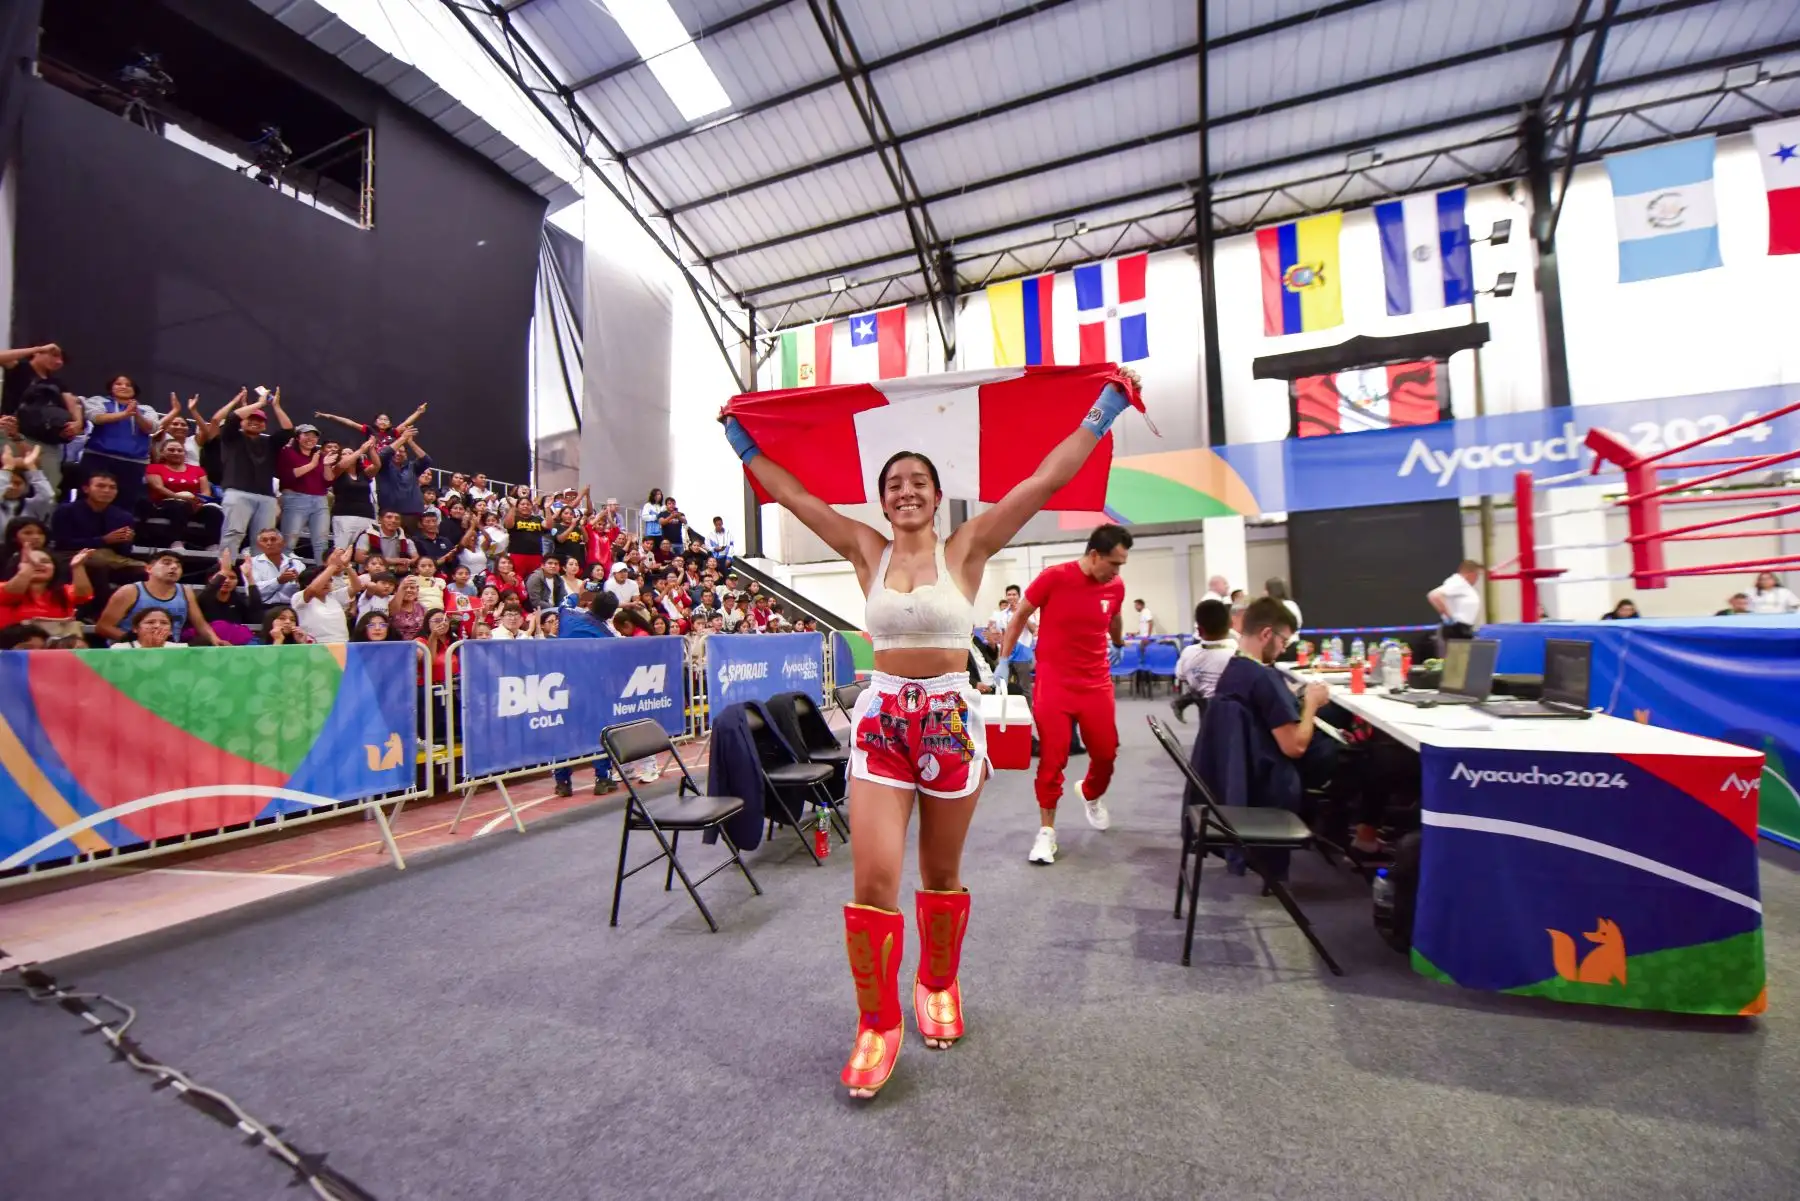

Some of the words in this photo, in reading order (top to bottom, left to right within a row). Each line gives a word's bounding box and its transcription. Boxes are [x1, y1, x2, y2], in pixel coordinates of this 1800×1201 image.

[728, 661, 768, 682] SPORADE
[782, 657, 818, 678] Ayacucho
[803, 670, 818, 680] 2024
[498, 672, 569, 717] BIG
[613, 702, 636, 716] New
[637, 695, 672, 712] Athletic
[529, 713, 564, 730] COLA
